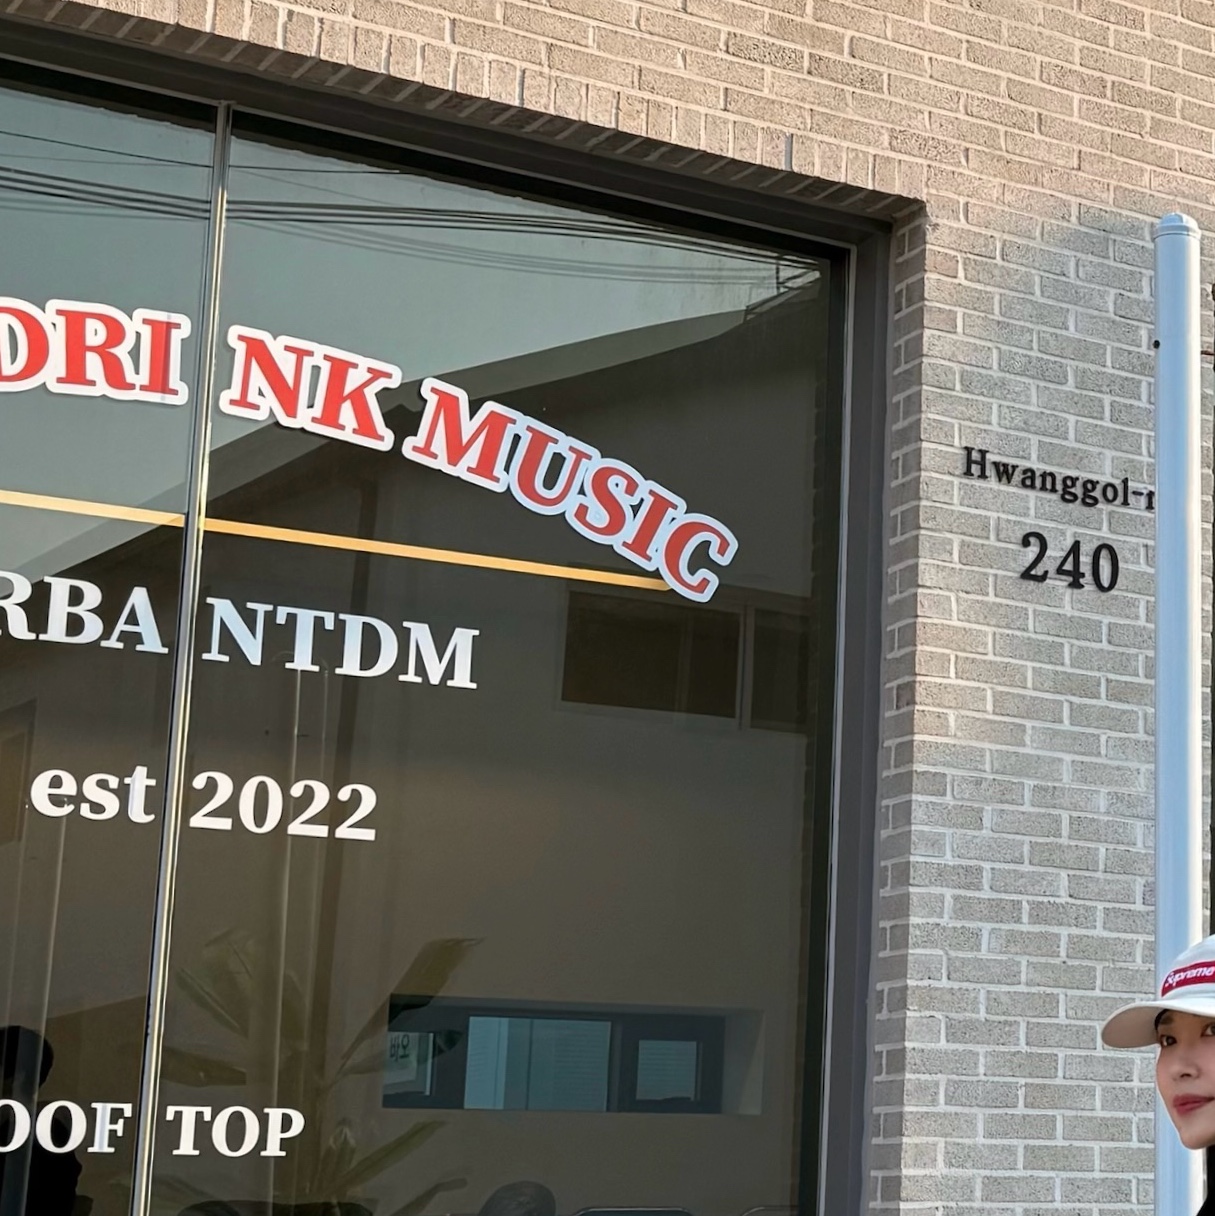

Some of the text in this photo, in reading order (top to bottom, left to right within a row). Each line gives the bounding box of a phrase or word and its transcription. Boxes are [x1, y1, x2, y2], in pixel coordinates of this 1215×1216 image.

[407, 382, 734, 599] MUSIC
[1020, 531, 1119, 592] 240
[30, 765, 377, 841] est 2022
[166, 1104, 305, 1157] TOP
